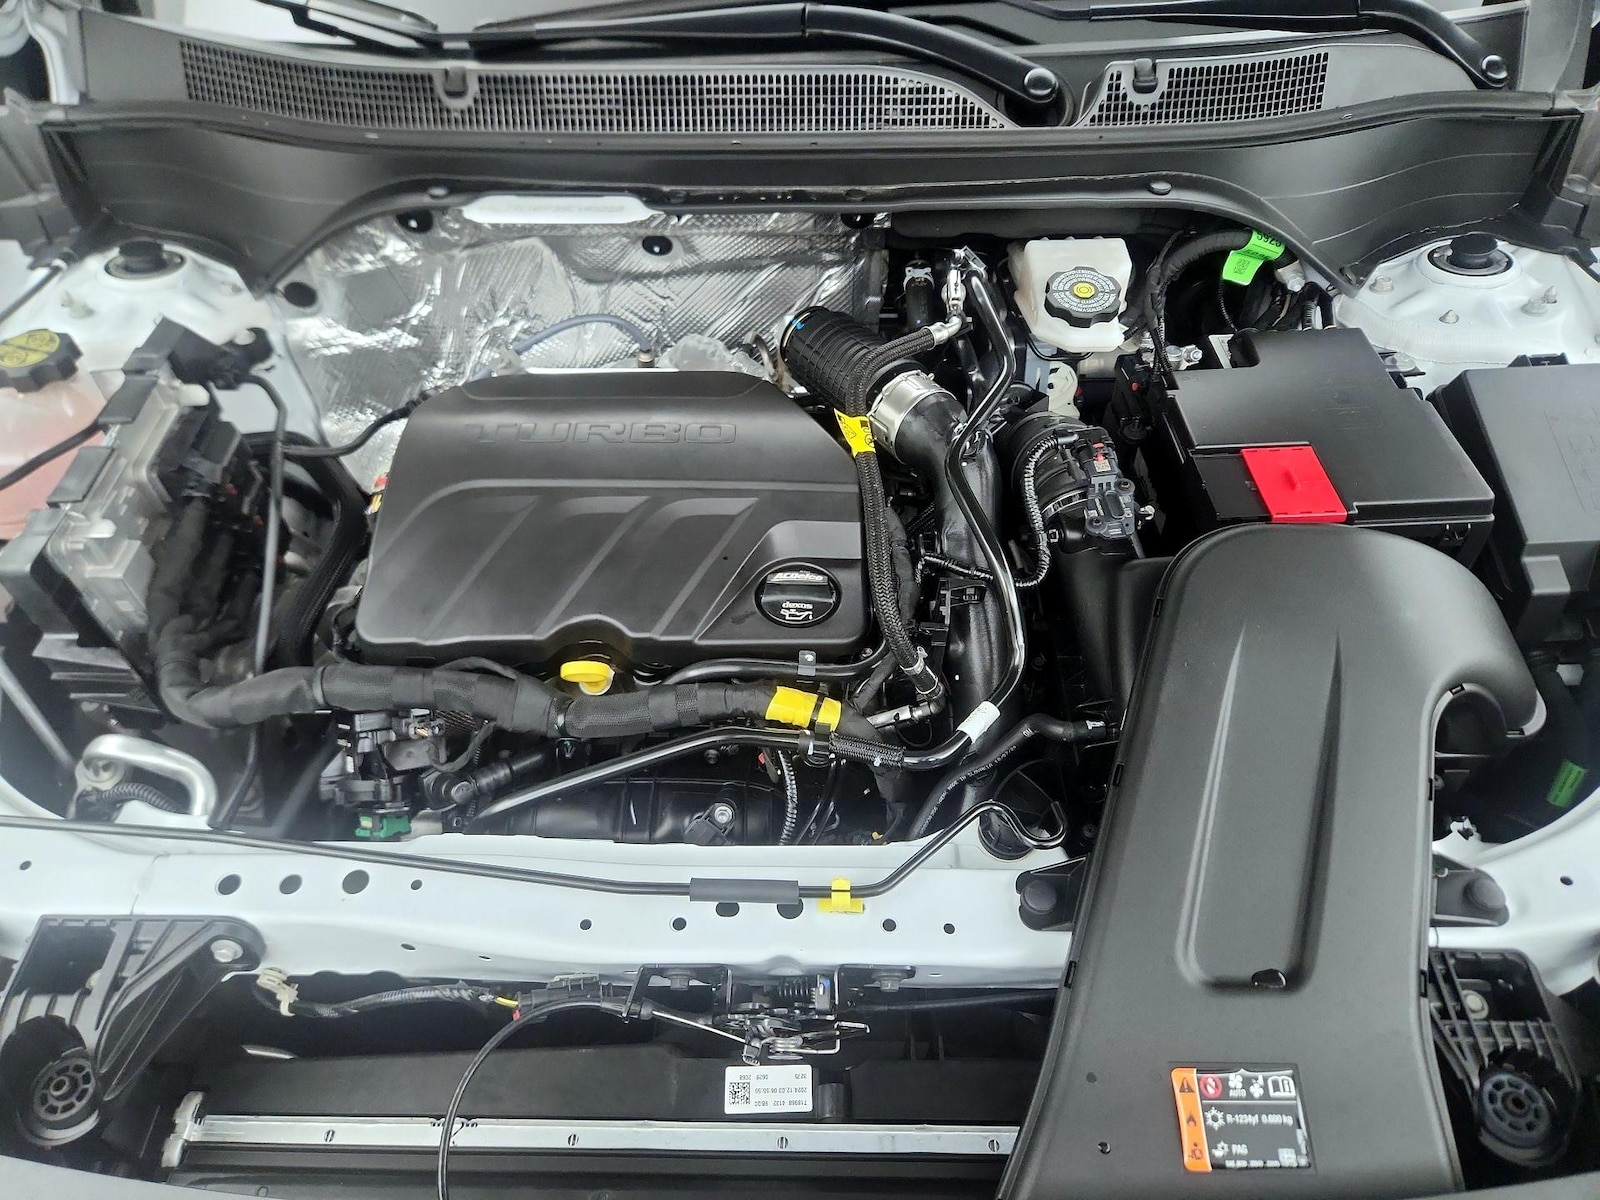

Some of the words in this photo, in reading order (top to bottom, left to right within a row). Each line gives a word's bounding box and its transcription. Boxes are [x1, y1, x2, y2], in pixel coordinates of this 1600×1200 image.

[464, 422, 737, 444] TURBO
[773, 572, 824, 581] ACDelco
[782, 601, 813, 609] dexos
[1229, 1088, 1246, 1098] AUTO
[1231, 1143, 1248, 1156] PAG
